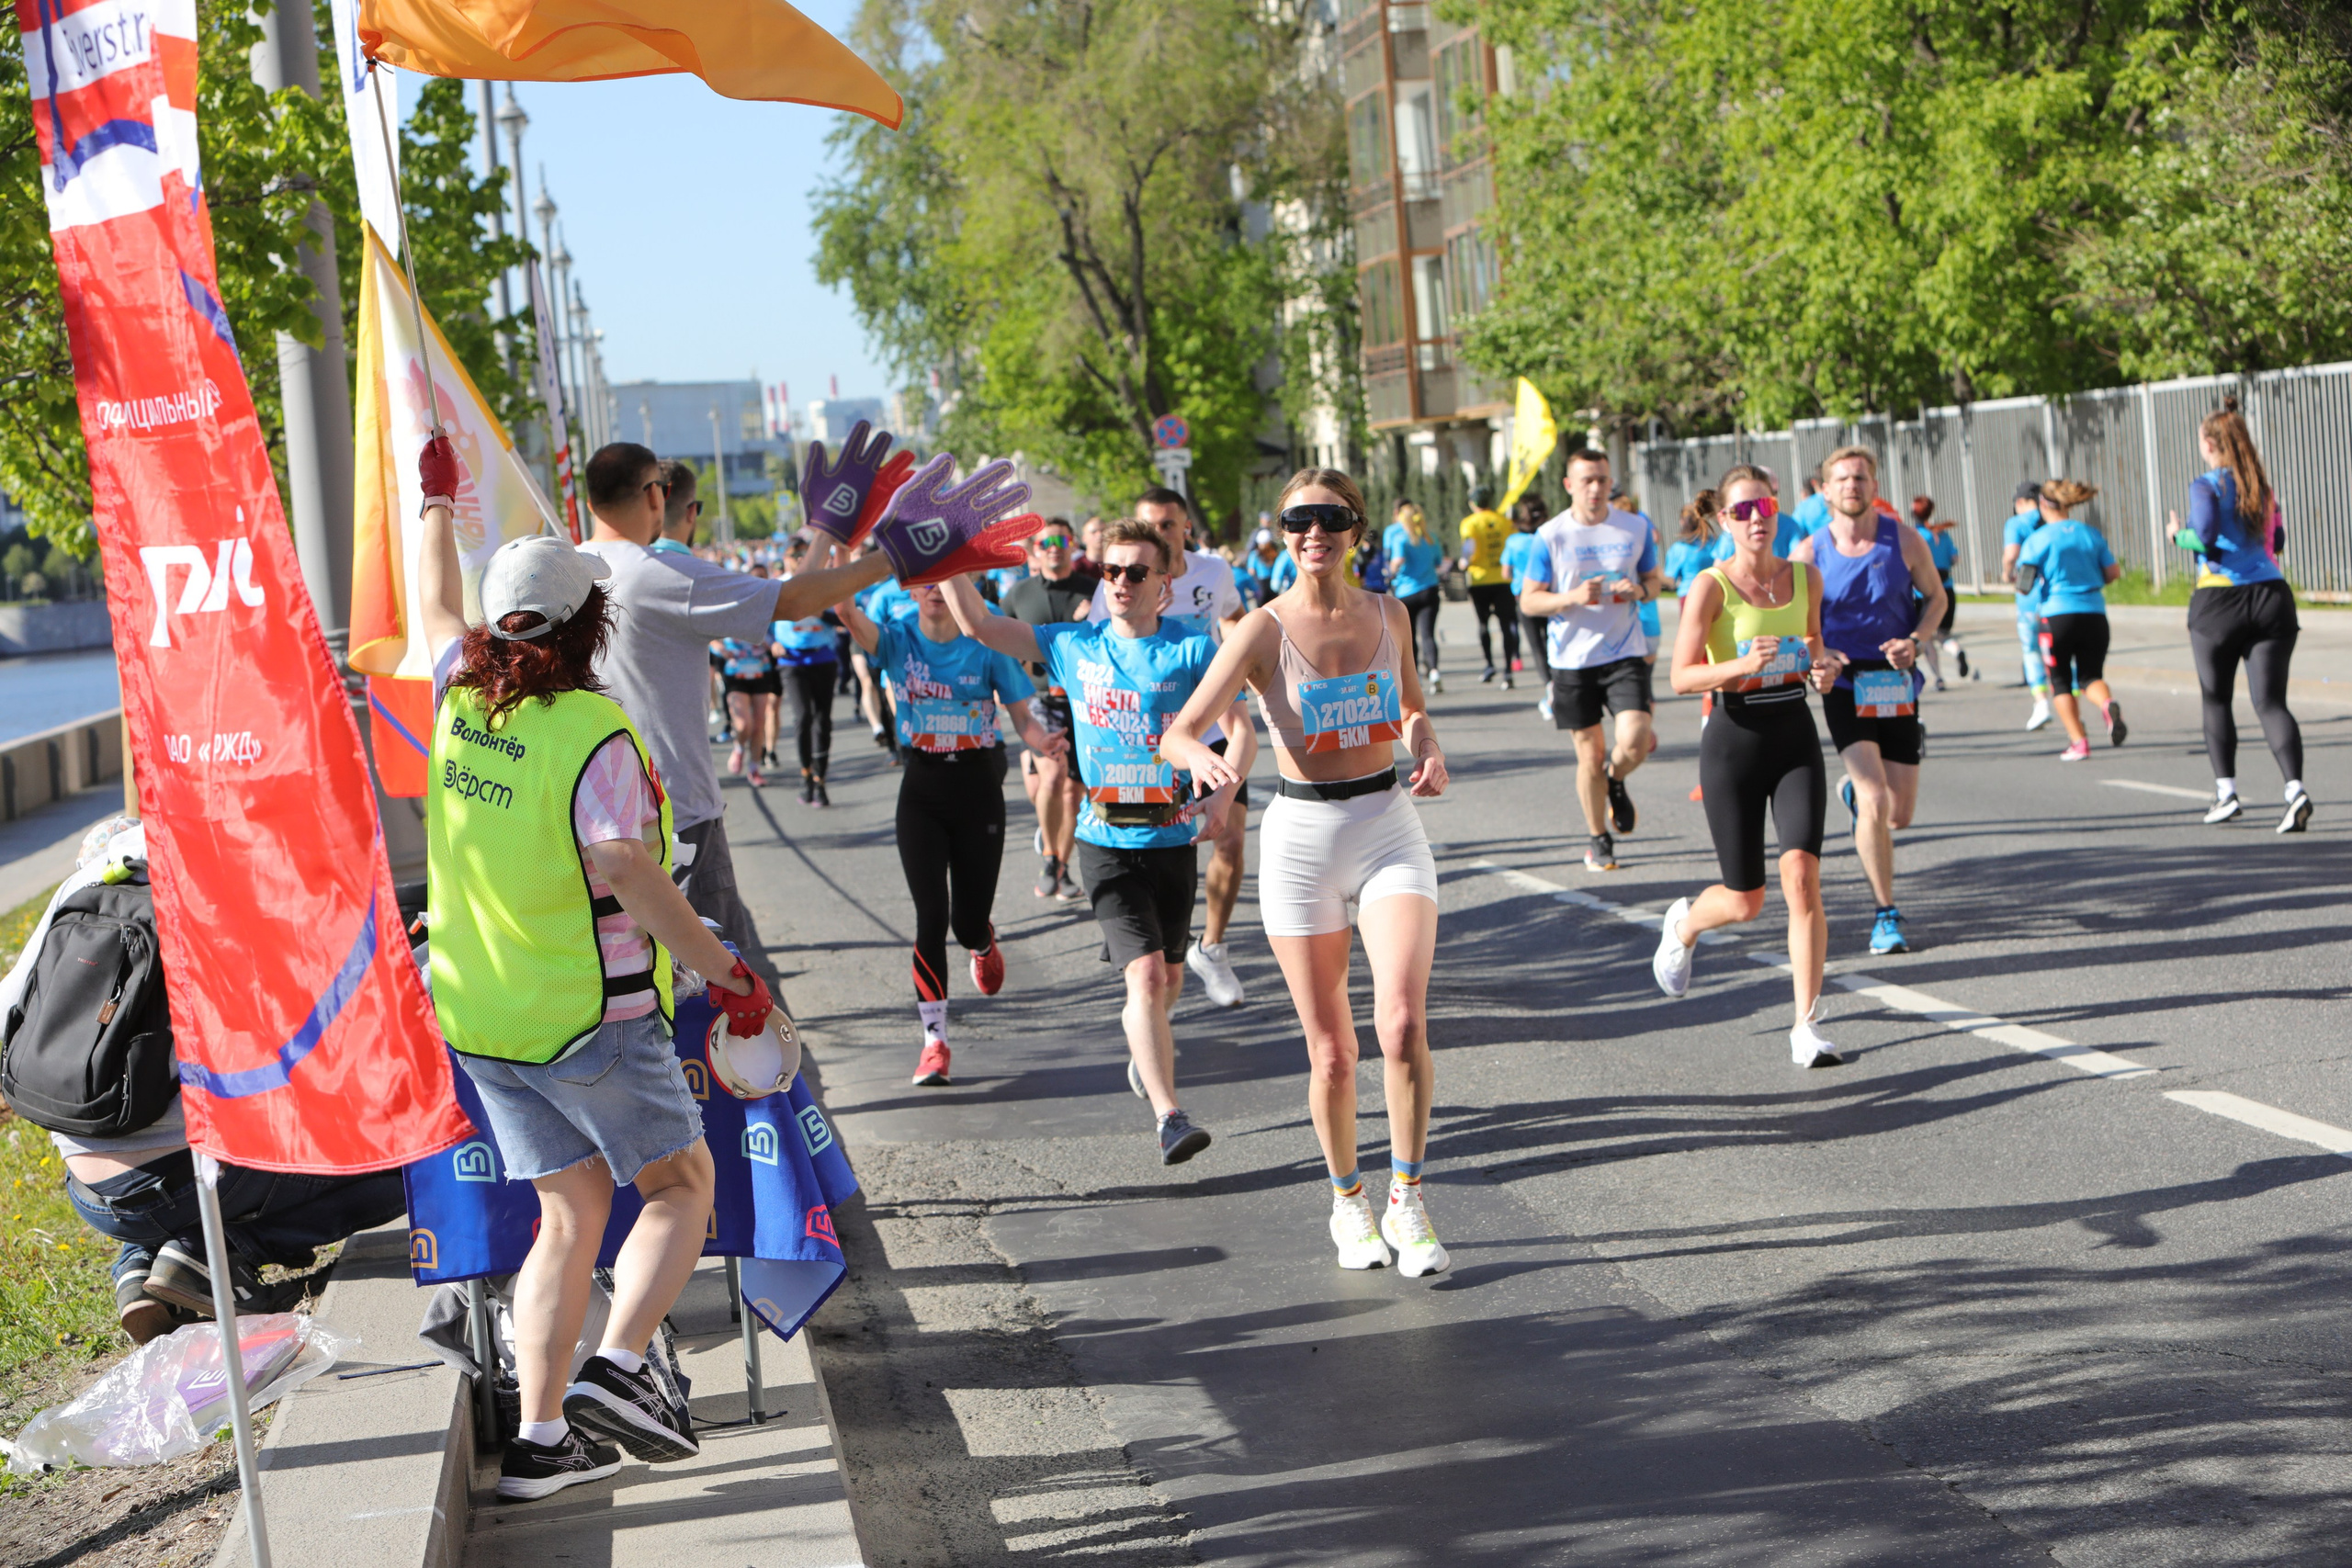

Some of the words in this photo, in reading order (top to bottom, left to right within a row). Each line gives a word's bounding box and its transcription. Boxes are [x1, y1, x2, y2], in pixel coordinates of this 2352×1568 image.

[1076, 659, 1115, 688] 2024
[1320, 694, 1383, 728] 27022
[450, 716, 526, 762] Волонтёр
[1105, 763, 1158, 784] 20078
